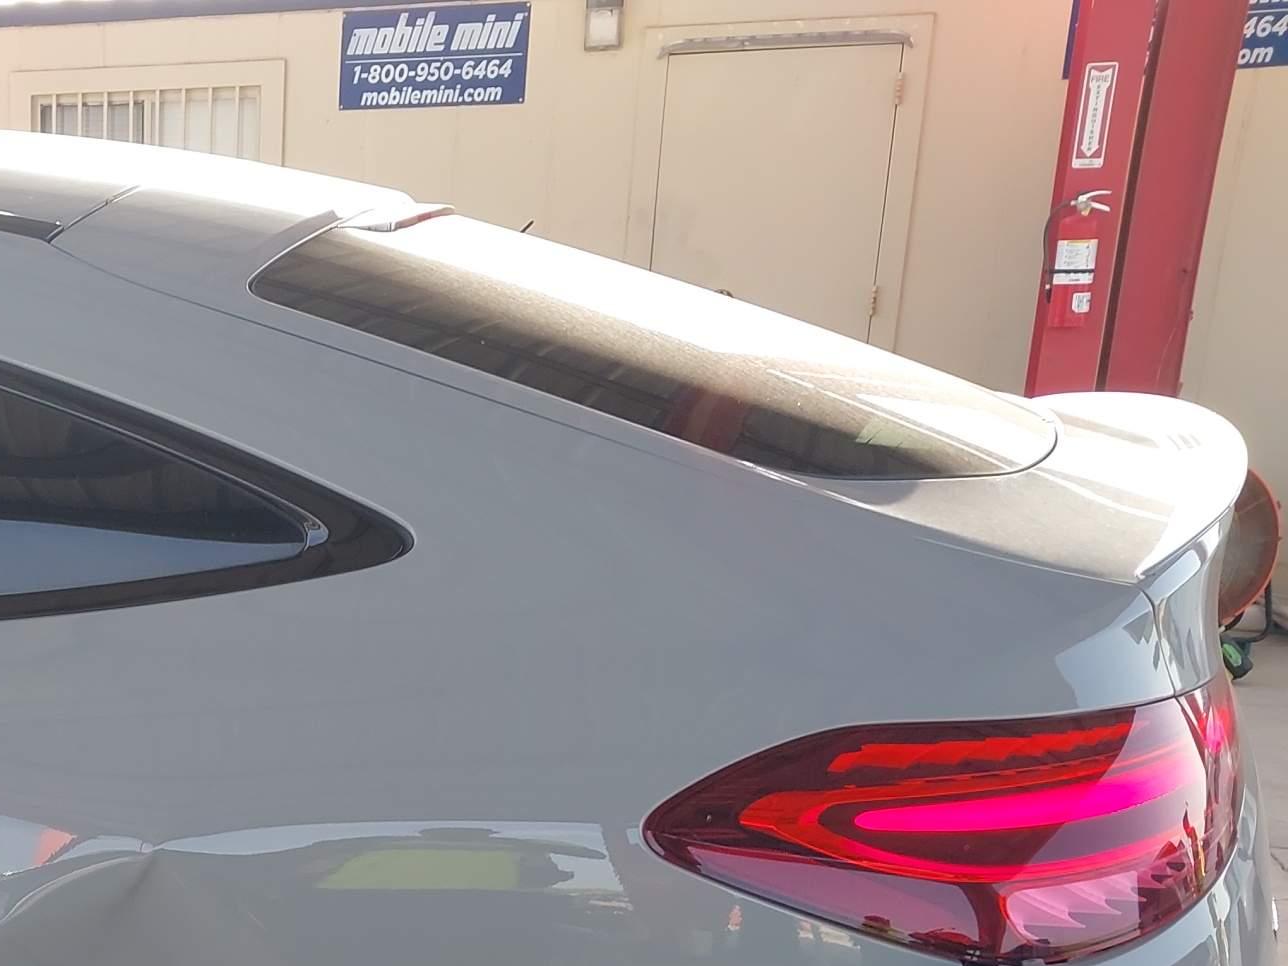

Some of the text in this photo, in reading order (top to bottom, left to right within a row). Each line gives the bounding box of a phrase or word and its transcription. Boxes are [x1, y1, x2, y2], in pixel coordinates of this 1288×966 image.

[346, 11, 523, 56] mobile mini
[352, 58, 513, 85] 1-800-950-6464
[360, 84, 503, 107] mobilemini.com
